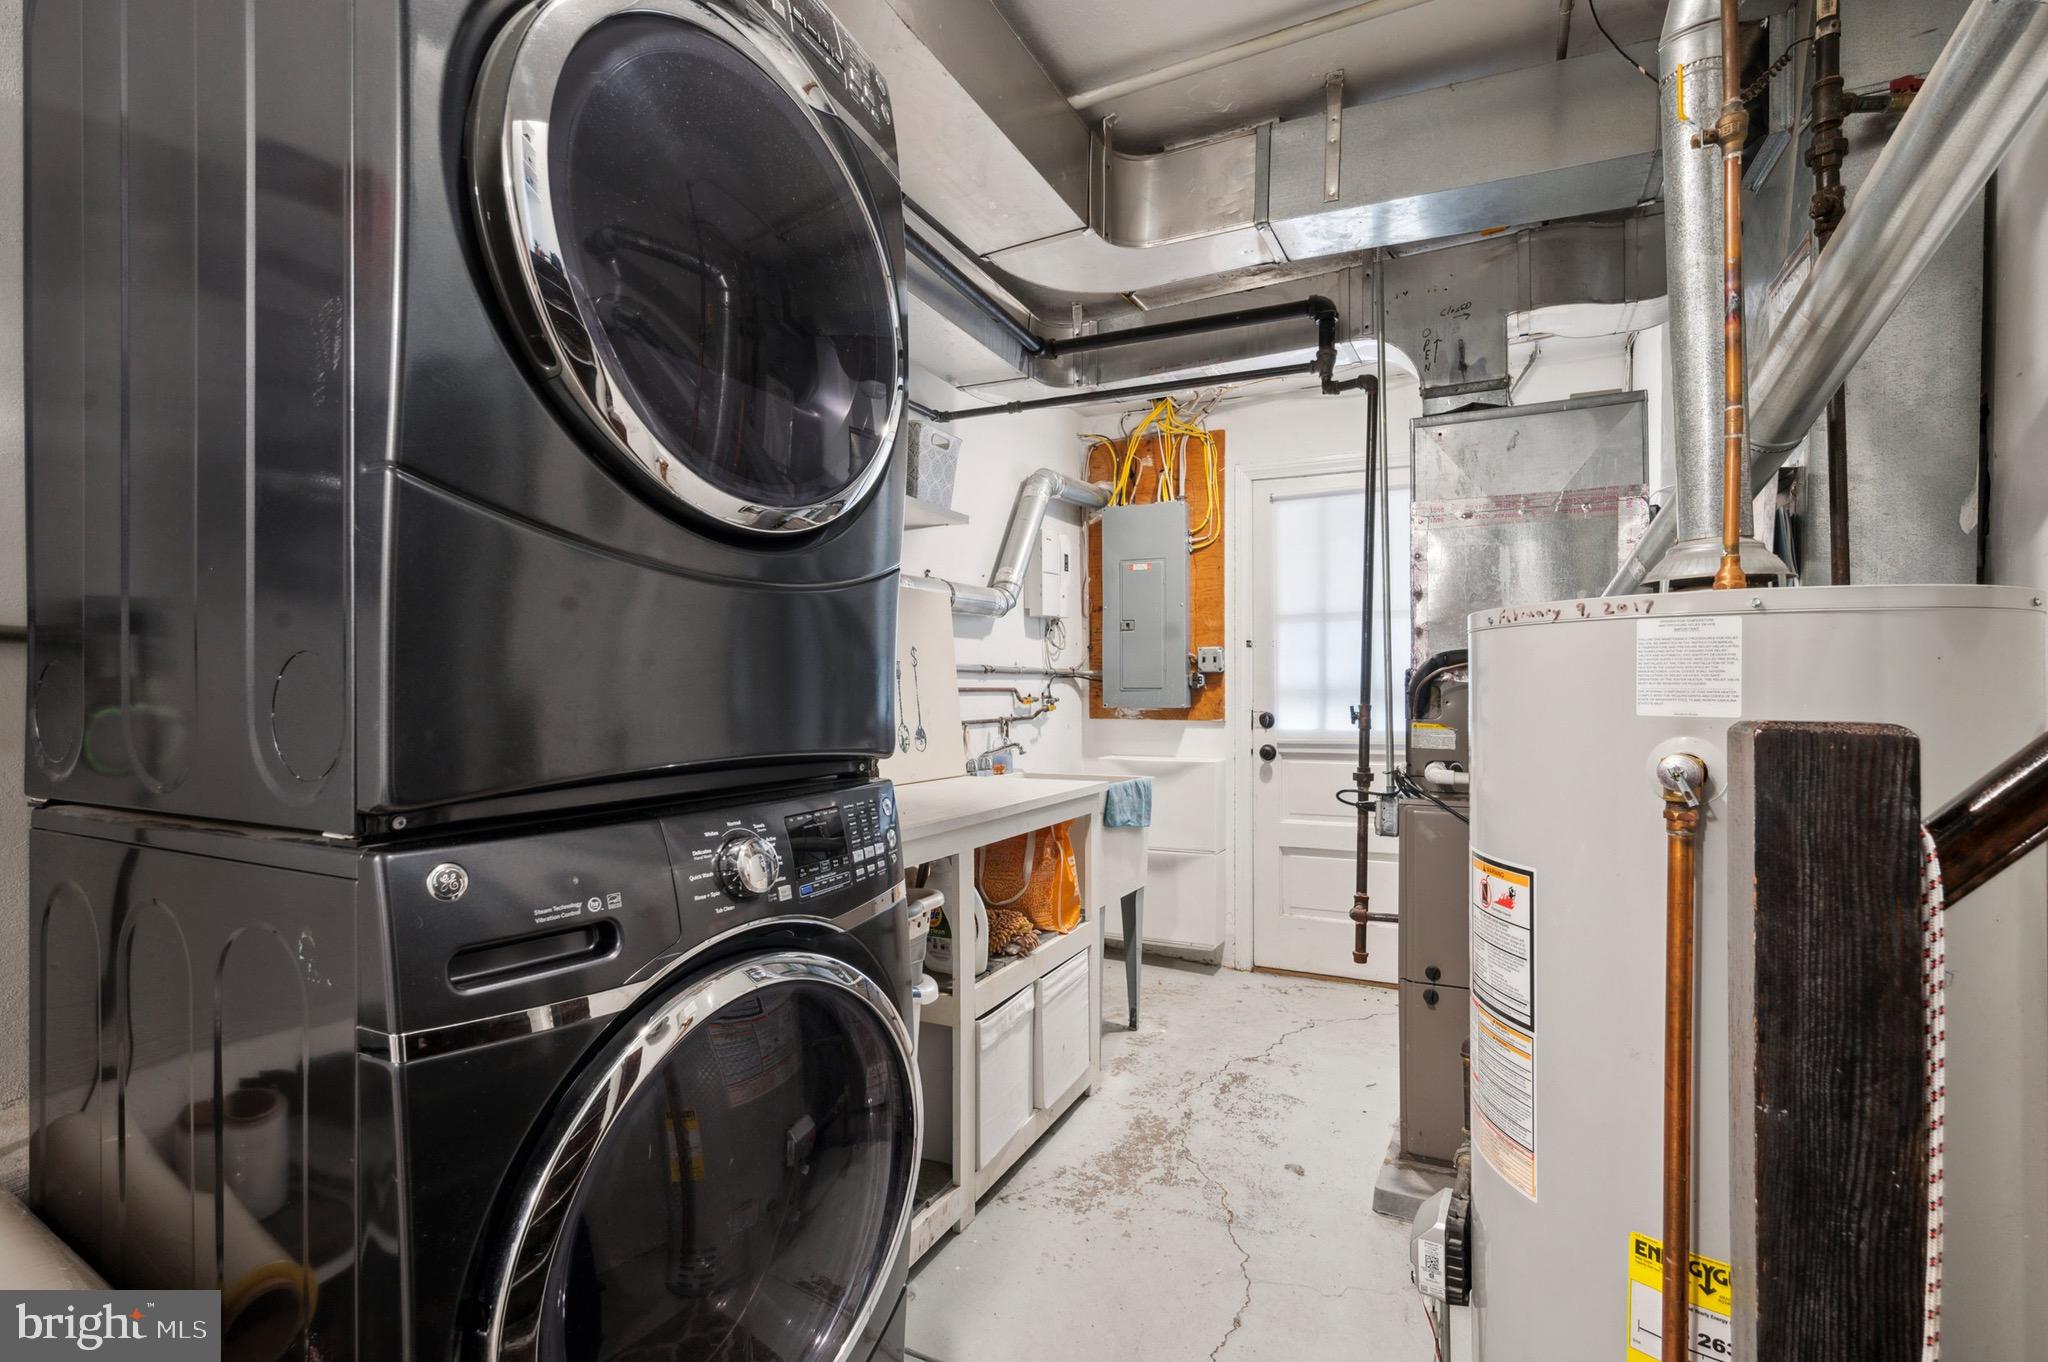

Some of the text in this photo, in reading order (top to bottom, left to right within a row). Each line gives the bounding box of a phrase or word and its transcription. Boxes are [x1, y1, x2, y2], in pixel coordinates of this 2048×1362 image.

[1603, 599, 1655, 614] 2017
[692, 848, 712, 856] Delicates
[689, 873, 702, 882] Quick
[534, 901, 582, 916] Steam Technology
[534, 908, 582, 924] Vibration Control
[1710, 1314, 1728, 1324] Energy
